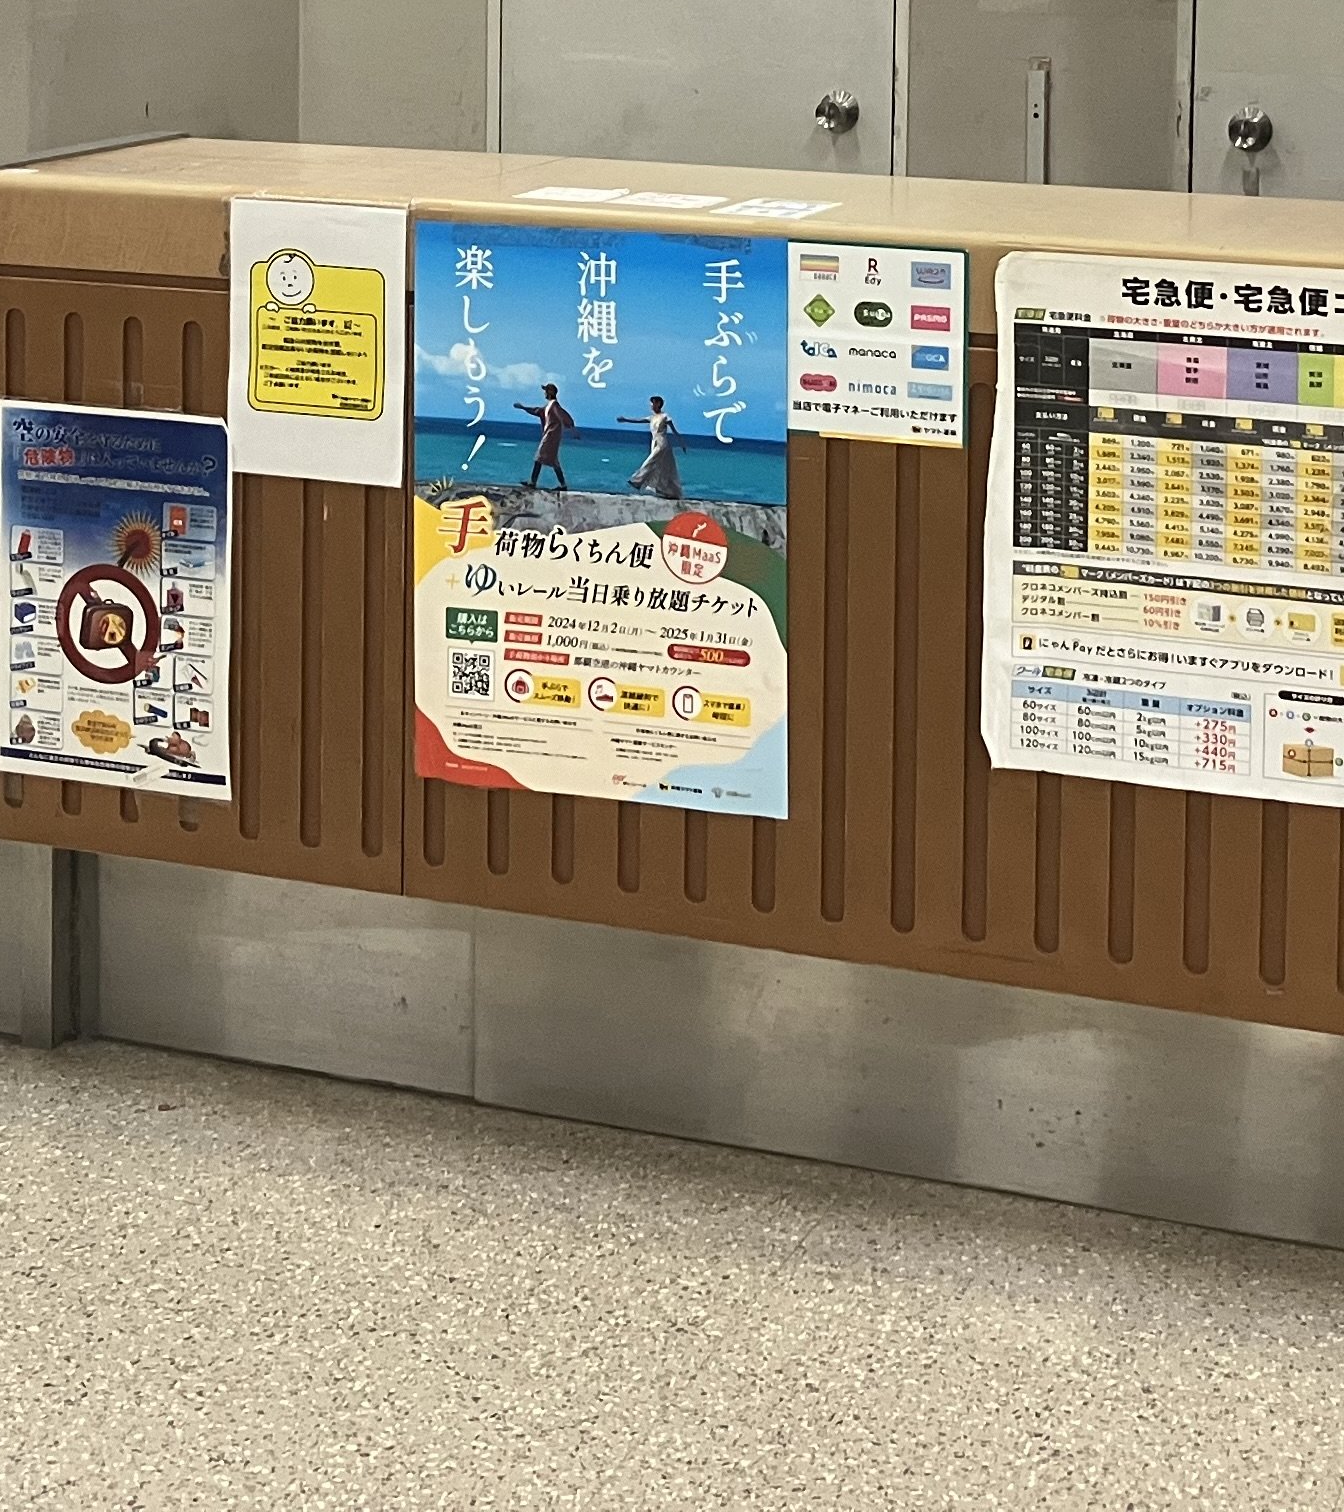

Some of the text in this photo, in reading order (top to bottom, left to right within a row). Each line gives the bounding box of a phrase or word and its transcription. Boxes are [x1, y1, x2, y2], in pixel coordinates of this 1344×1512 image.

[868, 258, 879, 274] R
[865, 278, 882, 286] Edy
[576, 252, 618, 389] 沖縄を
[454, 244, 495, 472] 楽しもう！
[702, 258, 745, 445] 手ぶらで
[848, 348, 896, 359] manaca
[848, 381, 896, 396] nimoca
[793, 401, 957, 423] 当店で電子マネーご利用いただけます
[439, 499, 655, 570] 手荷物らくちん便
[681, 562, 704, 577] 限定
[464, 563, 758, 619] ゆいレール当日乗り放題チケット
[457, 613, 487, 625] 購入は
[448, 624, 494, 638] こちらから
[1039, 638, 1069, 651] にゃん
[1073, 641, 1092, 655] Pay
